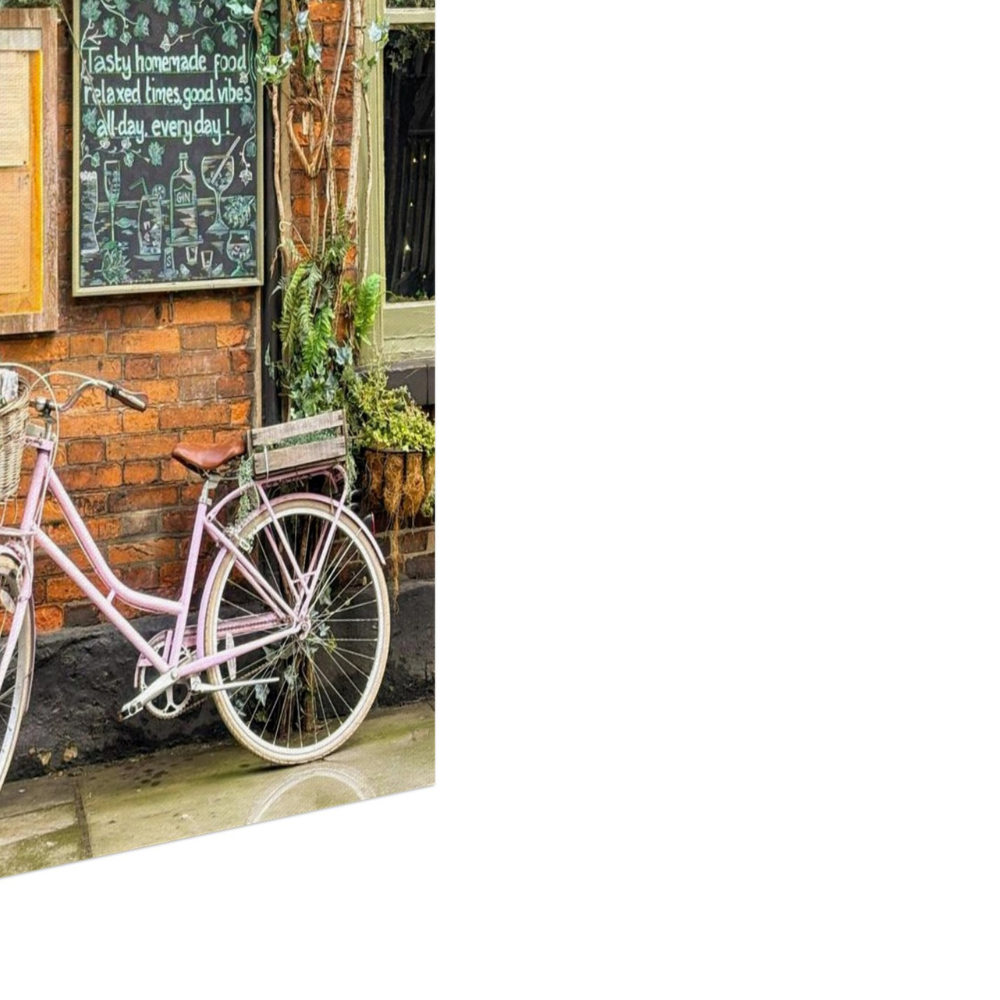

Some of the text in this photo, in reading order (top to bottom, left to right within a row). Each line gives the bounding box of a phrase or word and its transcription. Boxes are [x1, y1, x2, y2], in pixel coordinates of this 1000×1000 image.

[81, 44, 247, 80] Tasty homemade food
[84, 78, 140, 105] relaxed
[217, 76, 251, 104] vibes
[176, 191, 191, 203] GIN
